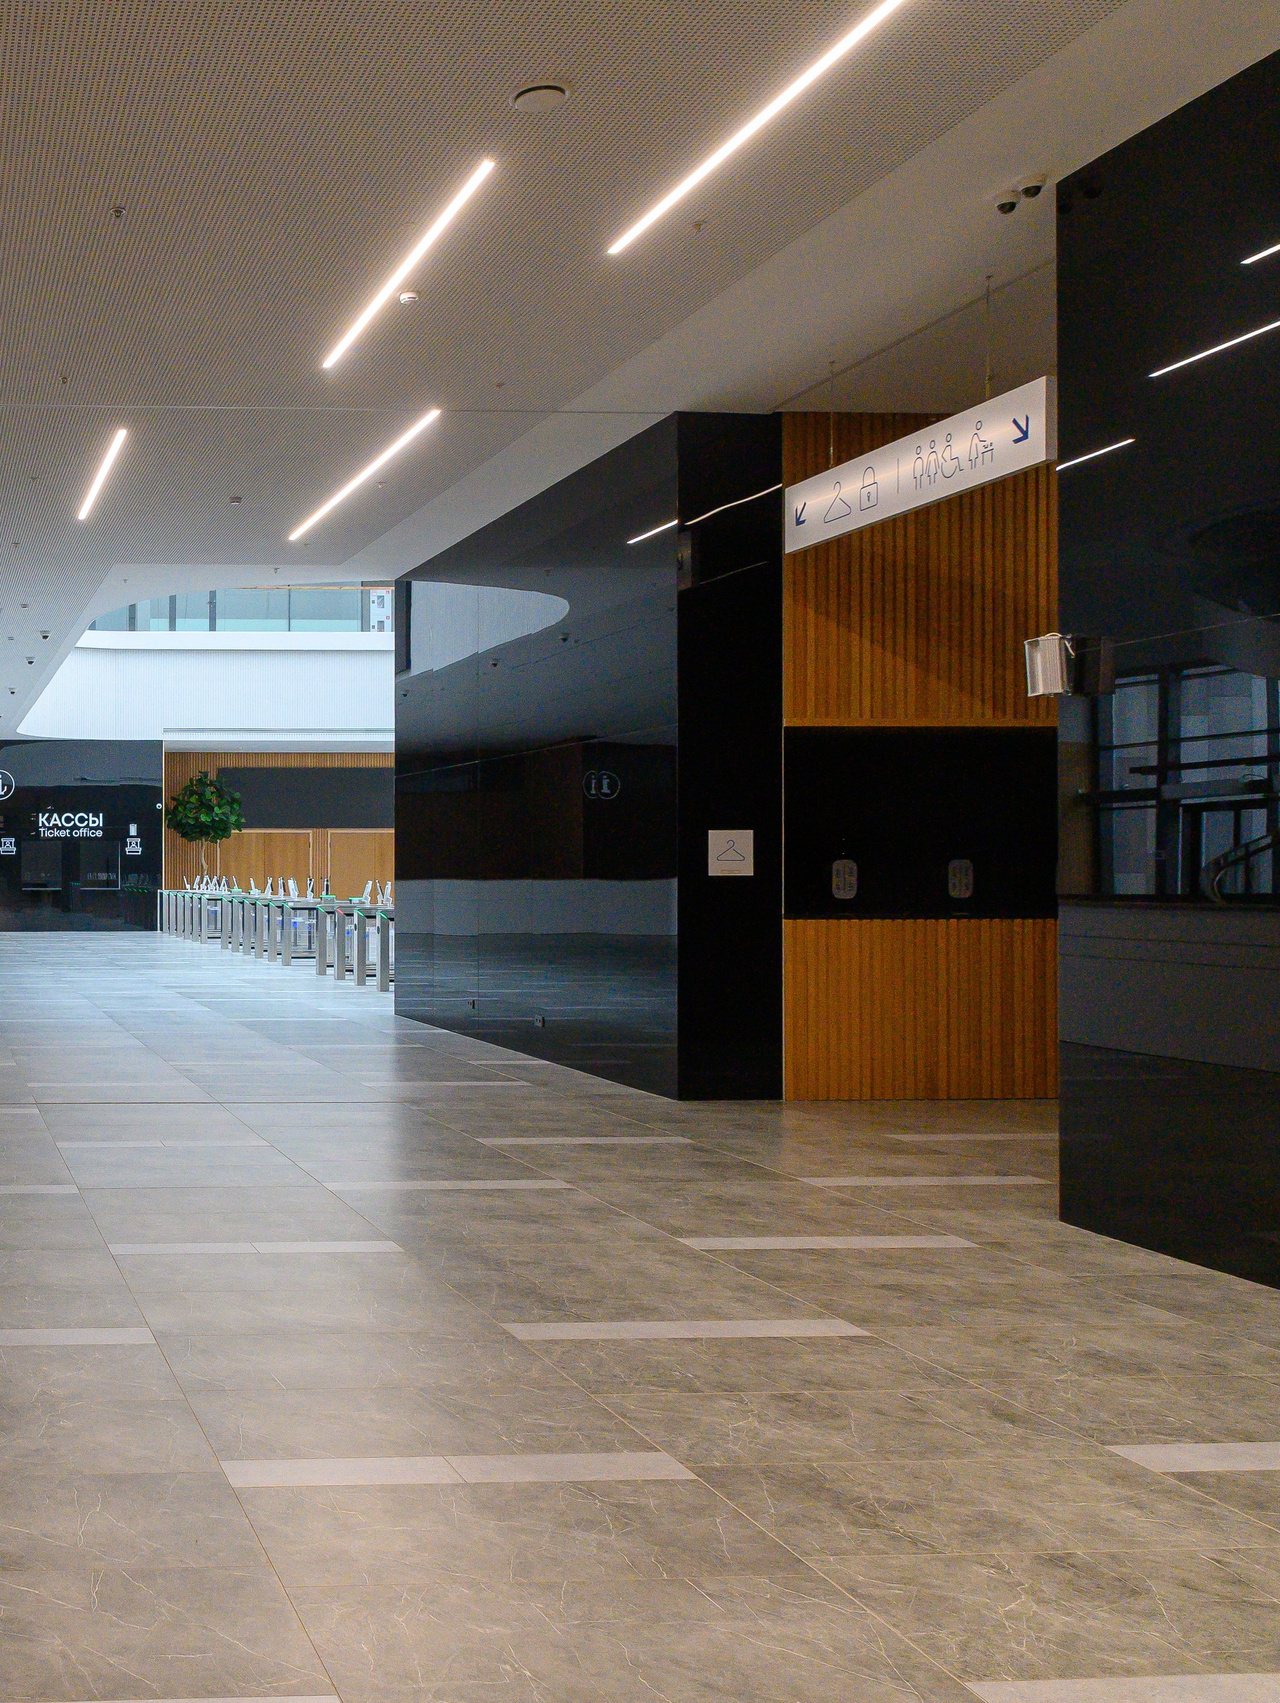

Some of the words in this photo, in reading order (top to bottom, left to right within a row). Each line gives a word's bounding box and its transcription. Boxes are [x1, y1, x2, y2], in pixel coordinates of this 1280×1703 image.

[38, 812, 103, 827] КАССЫ
[38, 827, 71, 838] Ticket
[72, 827, 103, 838] office
